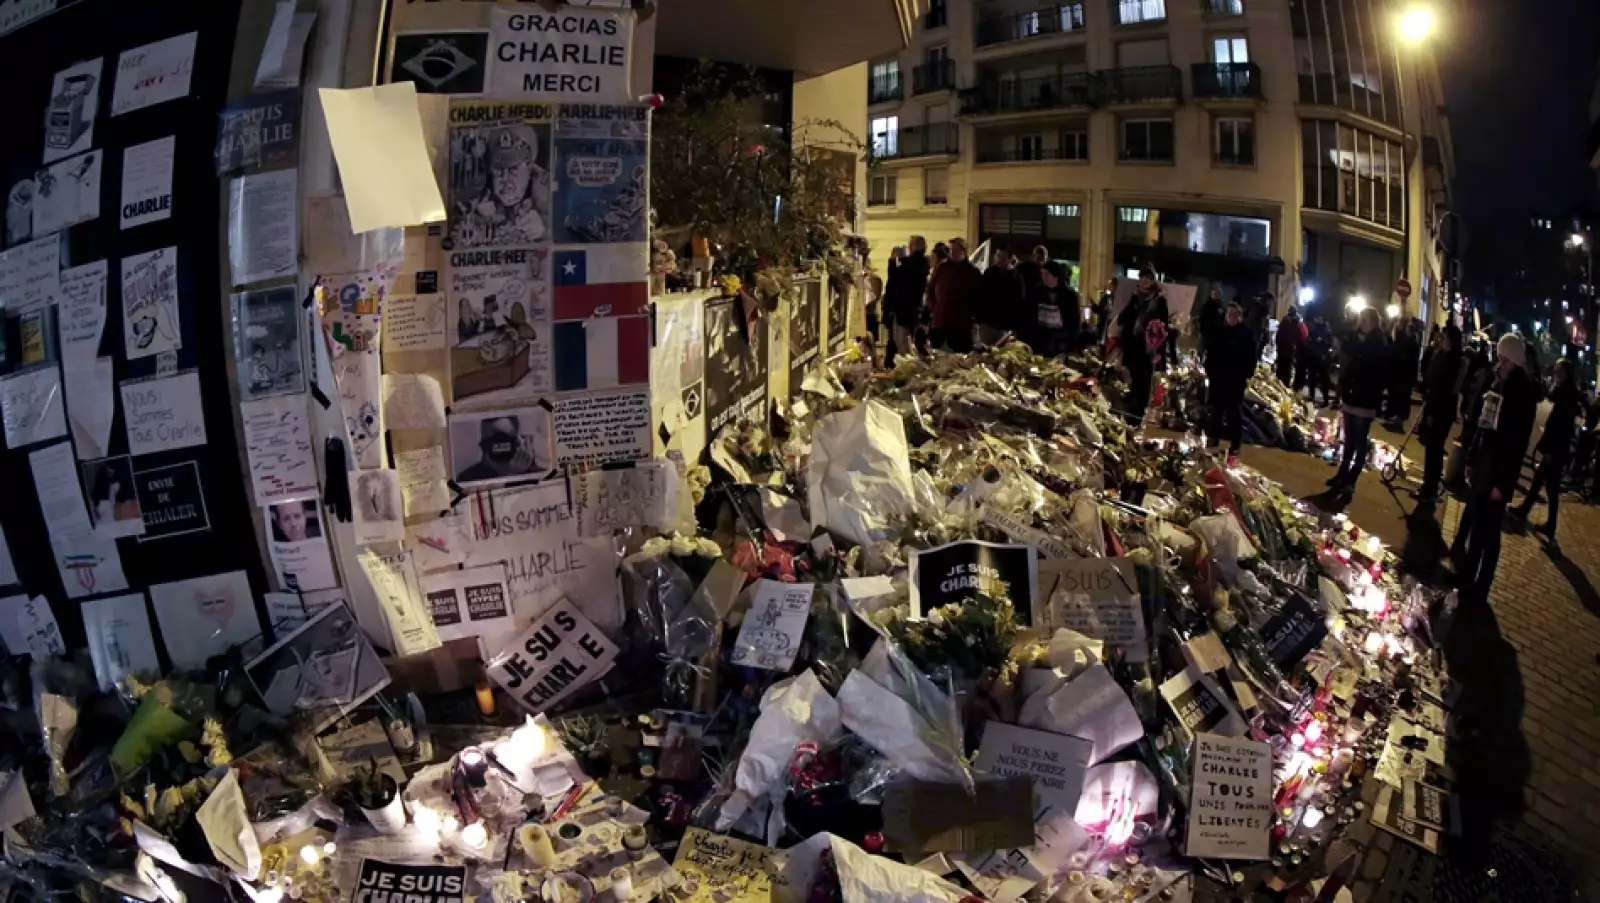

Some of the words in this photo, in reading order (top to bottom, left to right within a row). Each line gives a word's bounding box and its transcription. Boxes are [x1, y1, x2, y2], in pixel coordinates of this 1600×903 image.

[508, 14, 617, 35] GRACIAS
[497, 41, 625, 66] CHARLIE
[522, 73, 600, 93] MERCI
[242, 103, 283, 125] SUIS
[450, 105, 505, 122] CHARLIE
[558, 104, 611, 120] HARLIE
[220, 122, 292, 152] HARLIE
[122, 193, 171, 219] CHARLIE
[450, 250, 501, 267] CHARLIE
[132, 408, 174, 424] Sommes
[157, 420, 202, 442] Charlie
[148, 477, 175, 491] ENVIE
[157, 492, 170, 503] DE
[514, 500, 574, 532] SOMME
[947, 563, 965, 577] JE
[968, 562, 1000, 579] SUIS
[1065, 569, 1111, 592] SUIS
[470, 595, 501, 604] HYPER
[480, 586, 501, 595] SUIS
[501, 652, 534, 689] JE
[524, 611, 577, 661] SUS
[522, 632, 605, 708] CHARLE
[1012, 742, 1041, 759] VOUS
[1043, 750, 1060, 762] NE
[996, 751, 1028, 769] NOUS
[1030, 761, 1066, 777] FEREZ
[1202, 762, 1259, 779] CHARLIE
[1208, 781, 1255, 798] TOUS
[1199, 799, 1225, 811] UNIS
[361, 870, 396, 888] JE
[400, 872, 462, 895] SUIS
